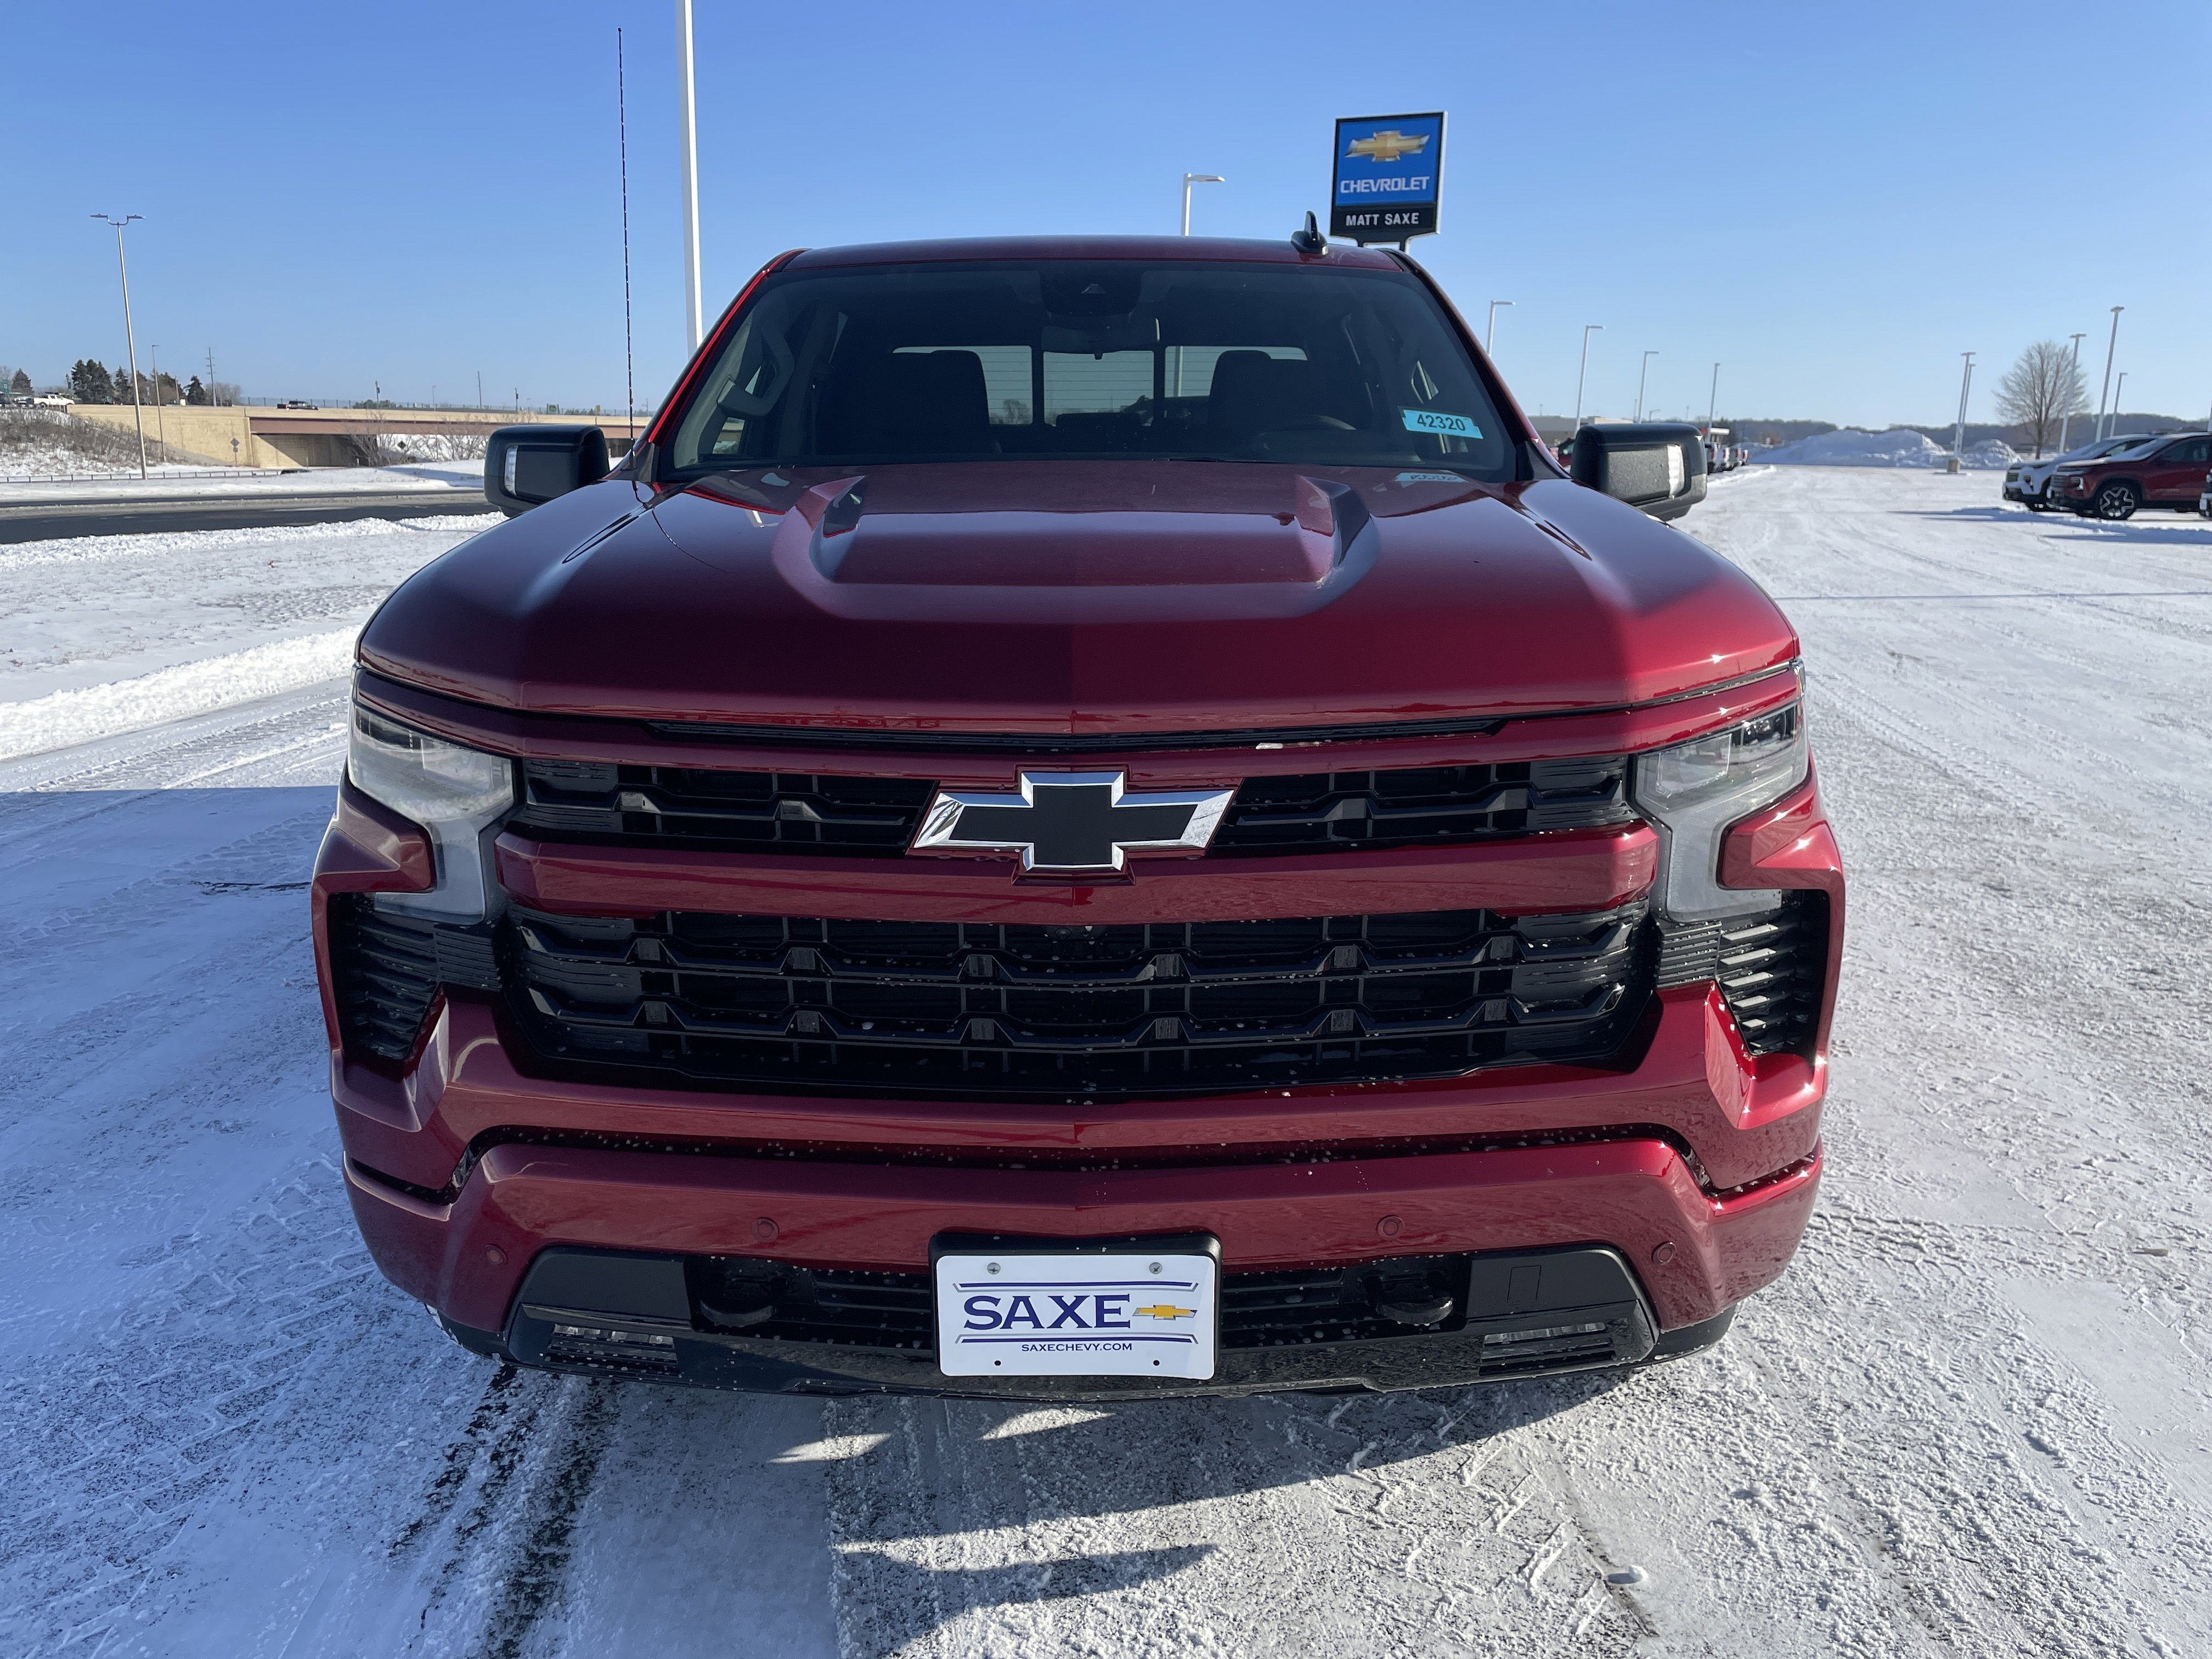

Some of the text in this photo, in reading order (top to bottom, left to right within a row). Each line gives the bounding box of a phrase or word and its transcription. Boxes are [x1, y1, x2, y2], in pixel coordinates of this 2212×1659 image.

[1340, 176, 1430, 193] CHEVROLET
[1346, 212, 1419, 226] MATT SAXE
[1417, 414, 1465, 431] 42320
[963, 1294, 1130, 1330] SAXE
[1022, 1343, 1132, 1352] SAXECHEVY.COM
